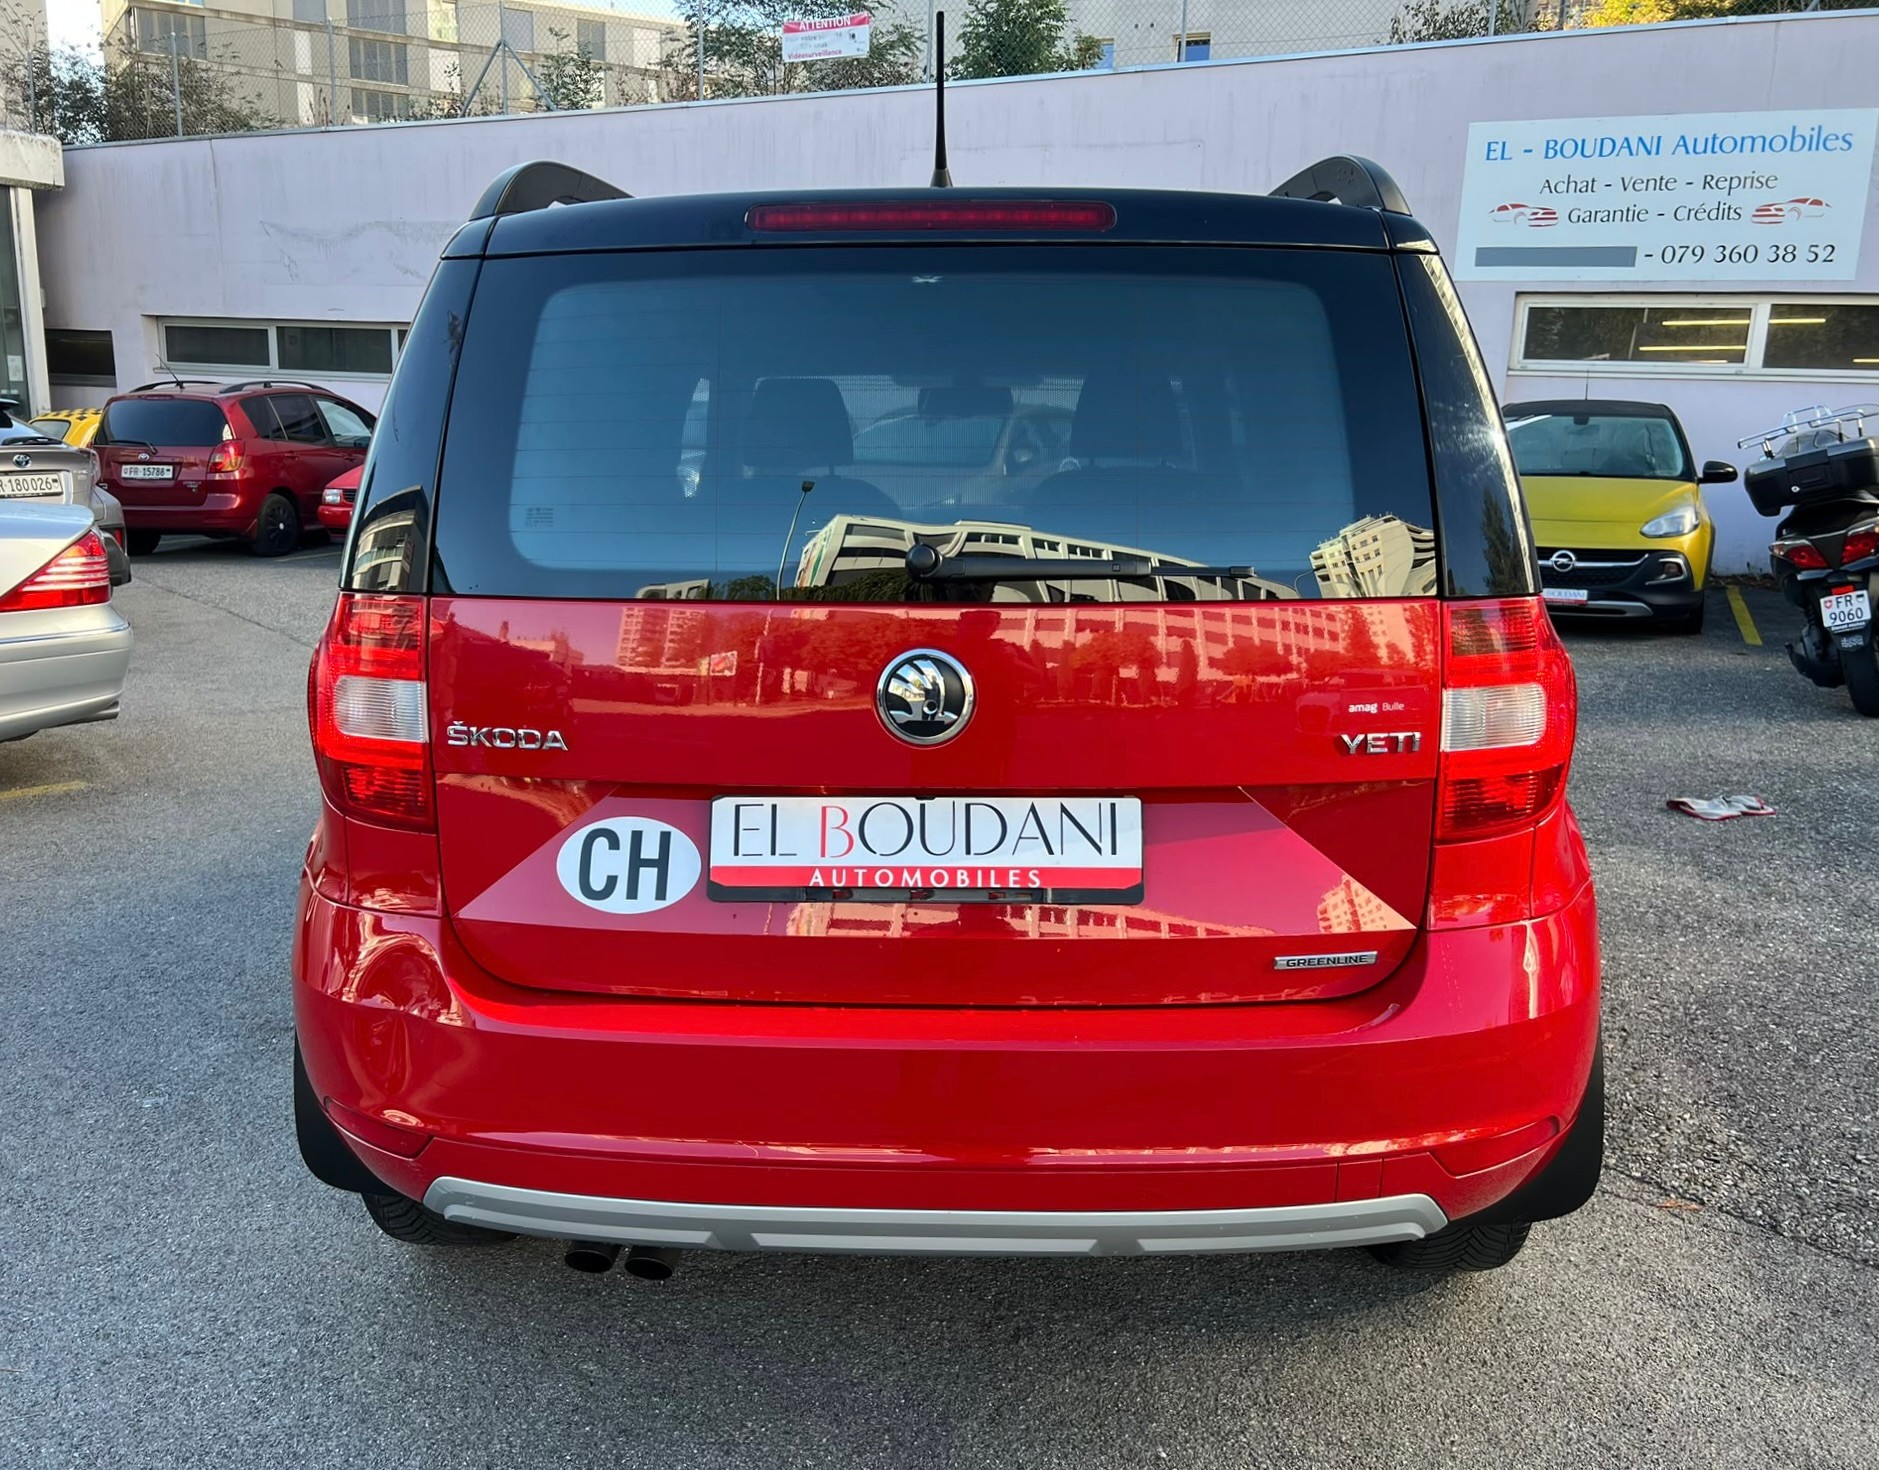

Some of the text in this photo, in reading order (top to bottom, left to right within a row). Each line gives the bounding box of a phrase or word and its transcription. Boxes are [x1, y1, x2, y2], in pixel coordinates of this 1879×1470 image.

[799, 17, 851, 31] ATTENTION
[1485, 141, 1512, 161] EL
[1543, 136, 1662, 159] BOUDANI
[1671, 125, 1854, 155] Automobiles
[1539, 174, 1597, 194] Achat
[1620, 174, 1677, 192] Vente
[1702, 170, 1778, 196] Reprise
[1567, 204, 1649, 223] Garantie
[1673, 202, 1742, 222] Crédits
[1661, 245, 1705, 264] 079
[1713, 244, 1759, 264] 360
[1767, 244, 1797, 264] 38
[1806, 244, 1836, 263] 52
[1835, 595, 1853, 609] FR
[1829, 607, 1863, 625] 9060
[1348, 702, 1404, 714] amag Bulle
[447, 721, 568, 750] ŠKODA
[1340, 732, 1421, 754] YETI
[733, 801, 1117, 858] EL BOUDANI
[578, 827, 672, 901] CH
[809, 868, 1041, 888] AUTOMOBILES
[1286, 955, 1368, 967] GREENLINE
